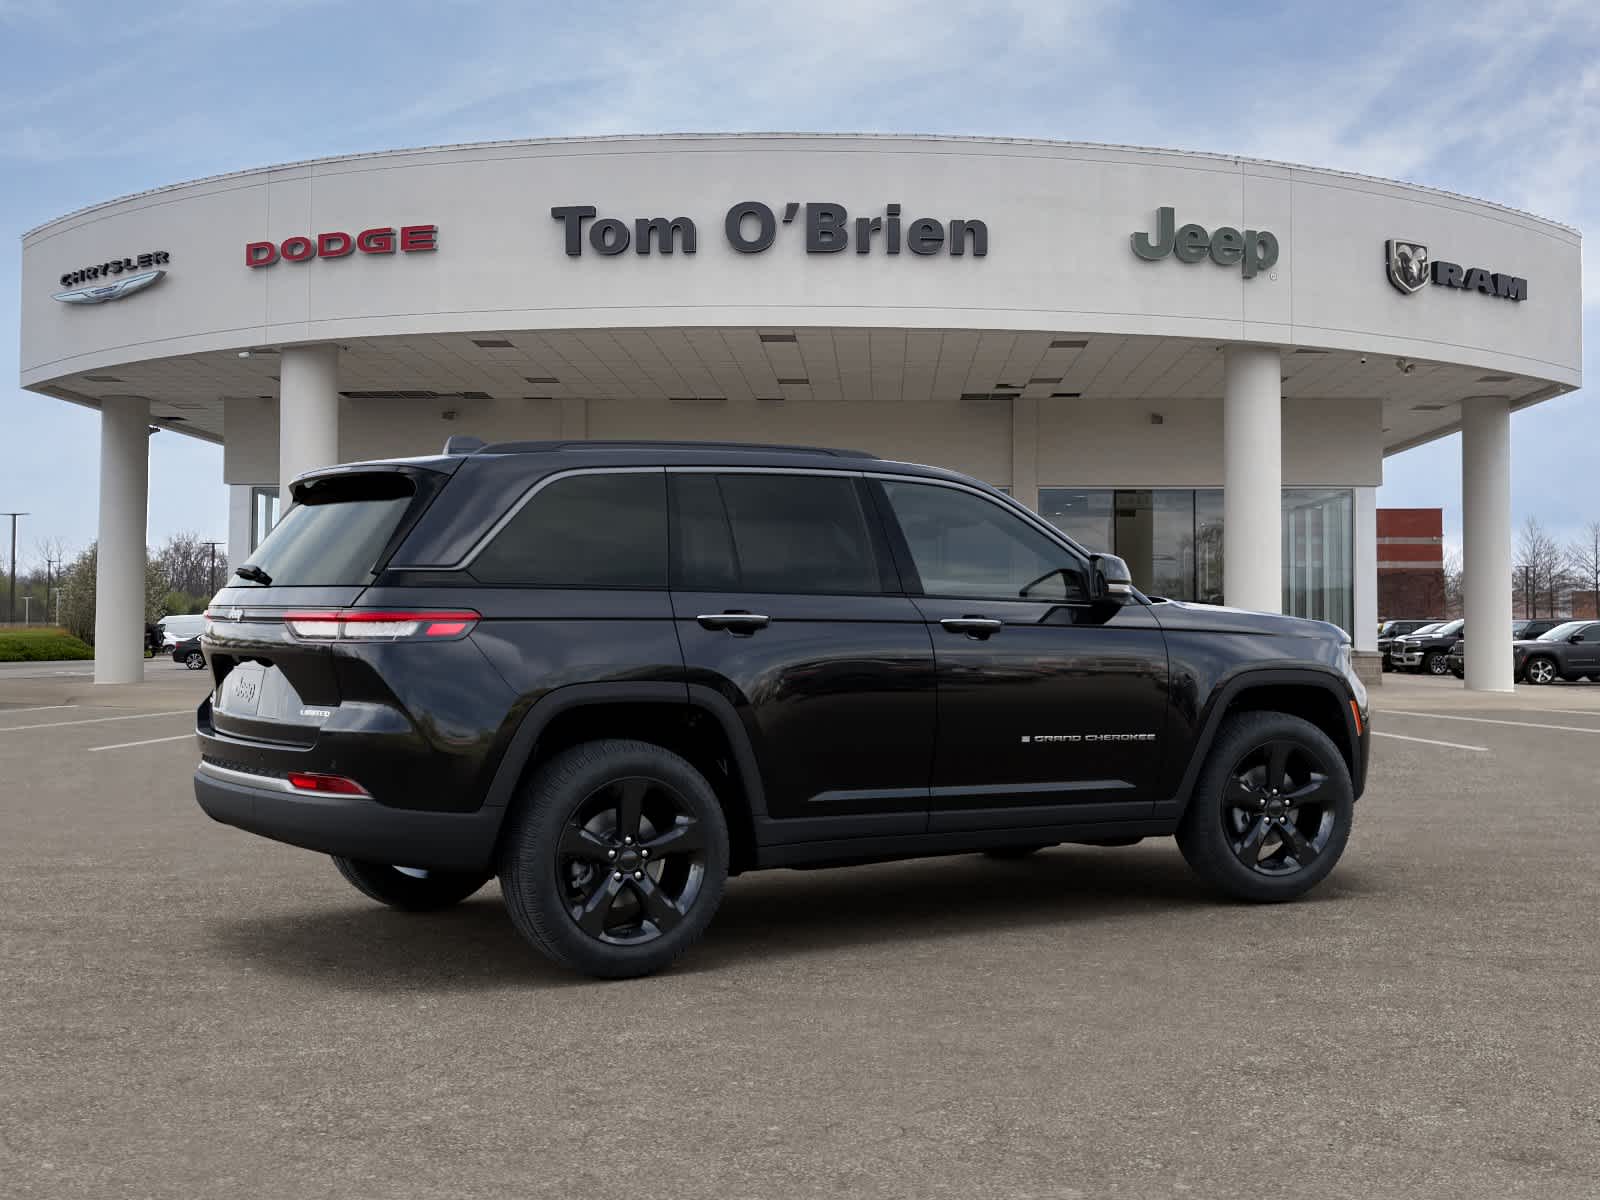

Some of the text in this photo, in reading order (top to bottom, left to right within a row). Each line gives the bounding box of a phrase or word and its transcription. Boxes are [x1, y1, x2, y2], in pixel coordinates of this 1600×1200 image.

[245, 225, 438, 269] DODGE
[551, 201, 989, 256] Tom O’Brien
[1130, 207, 1279, 279] Jeep
[60, 250, 169, 286] CHRYSLER
[1431, 260, 1528, 302] RAM
[1034, 733, 1157, 743] GRAND CHEROKEE
